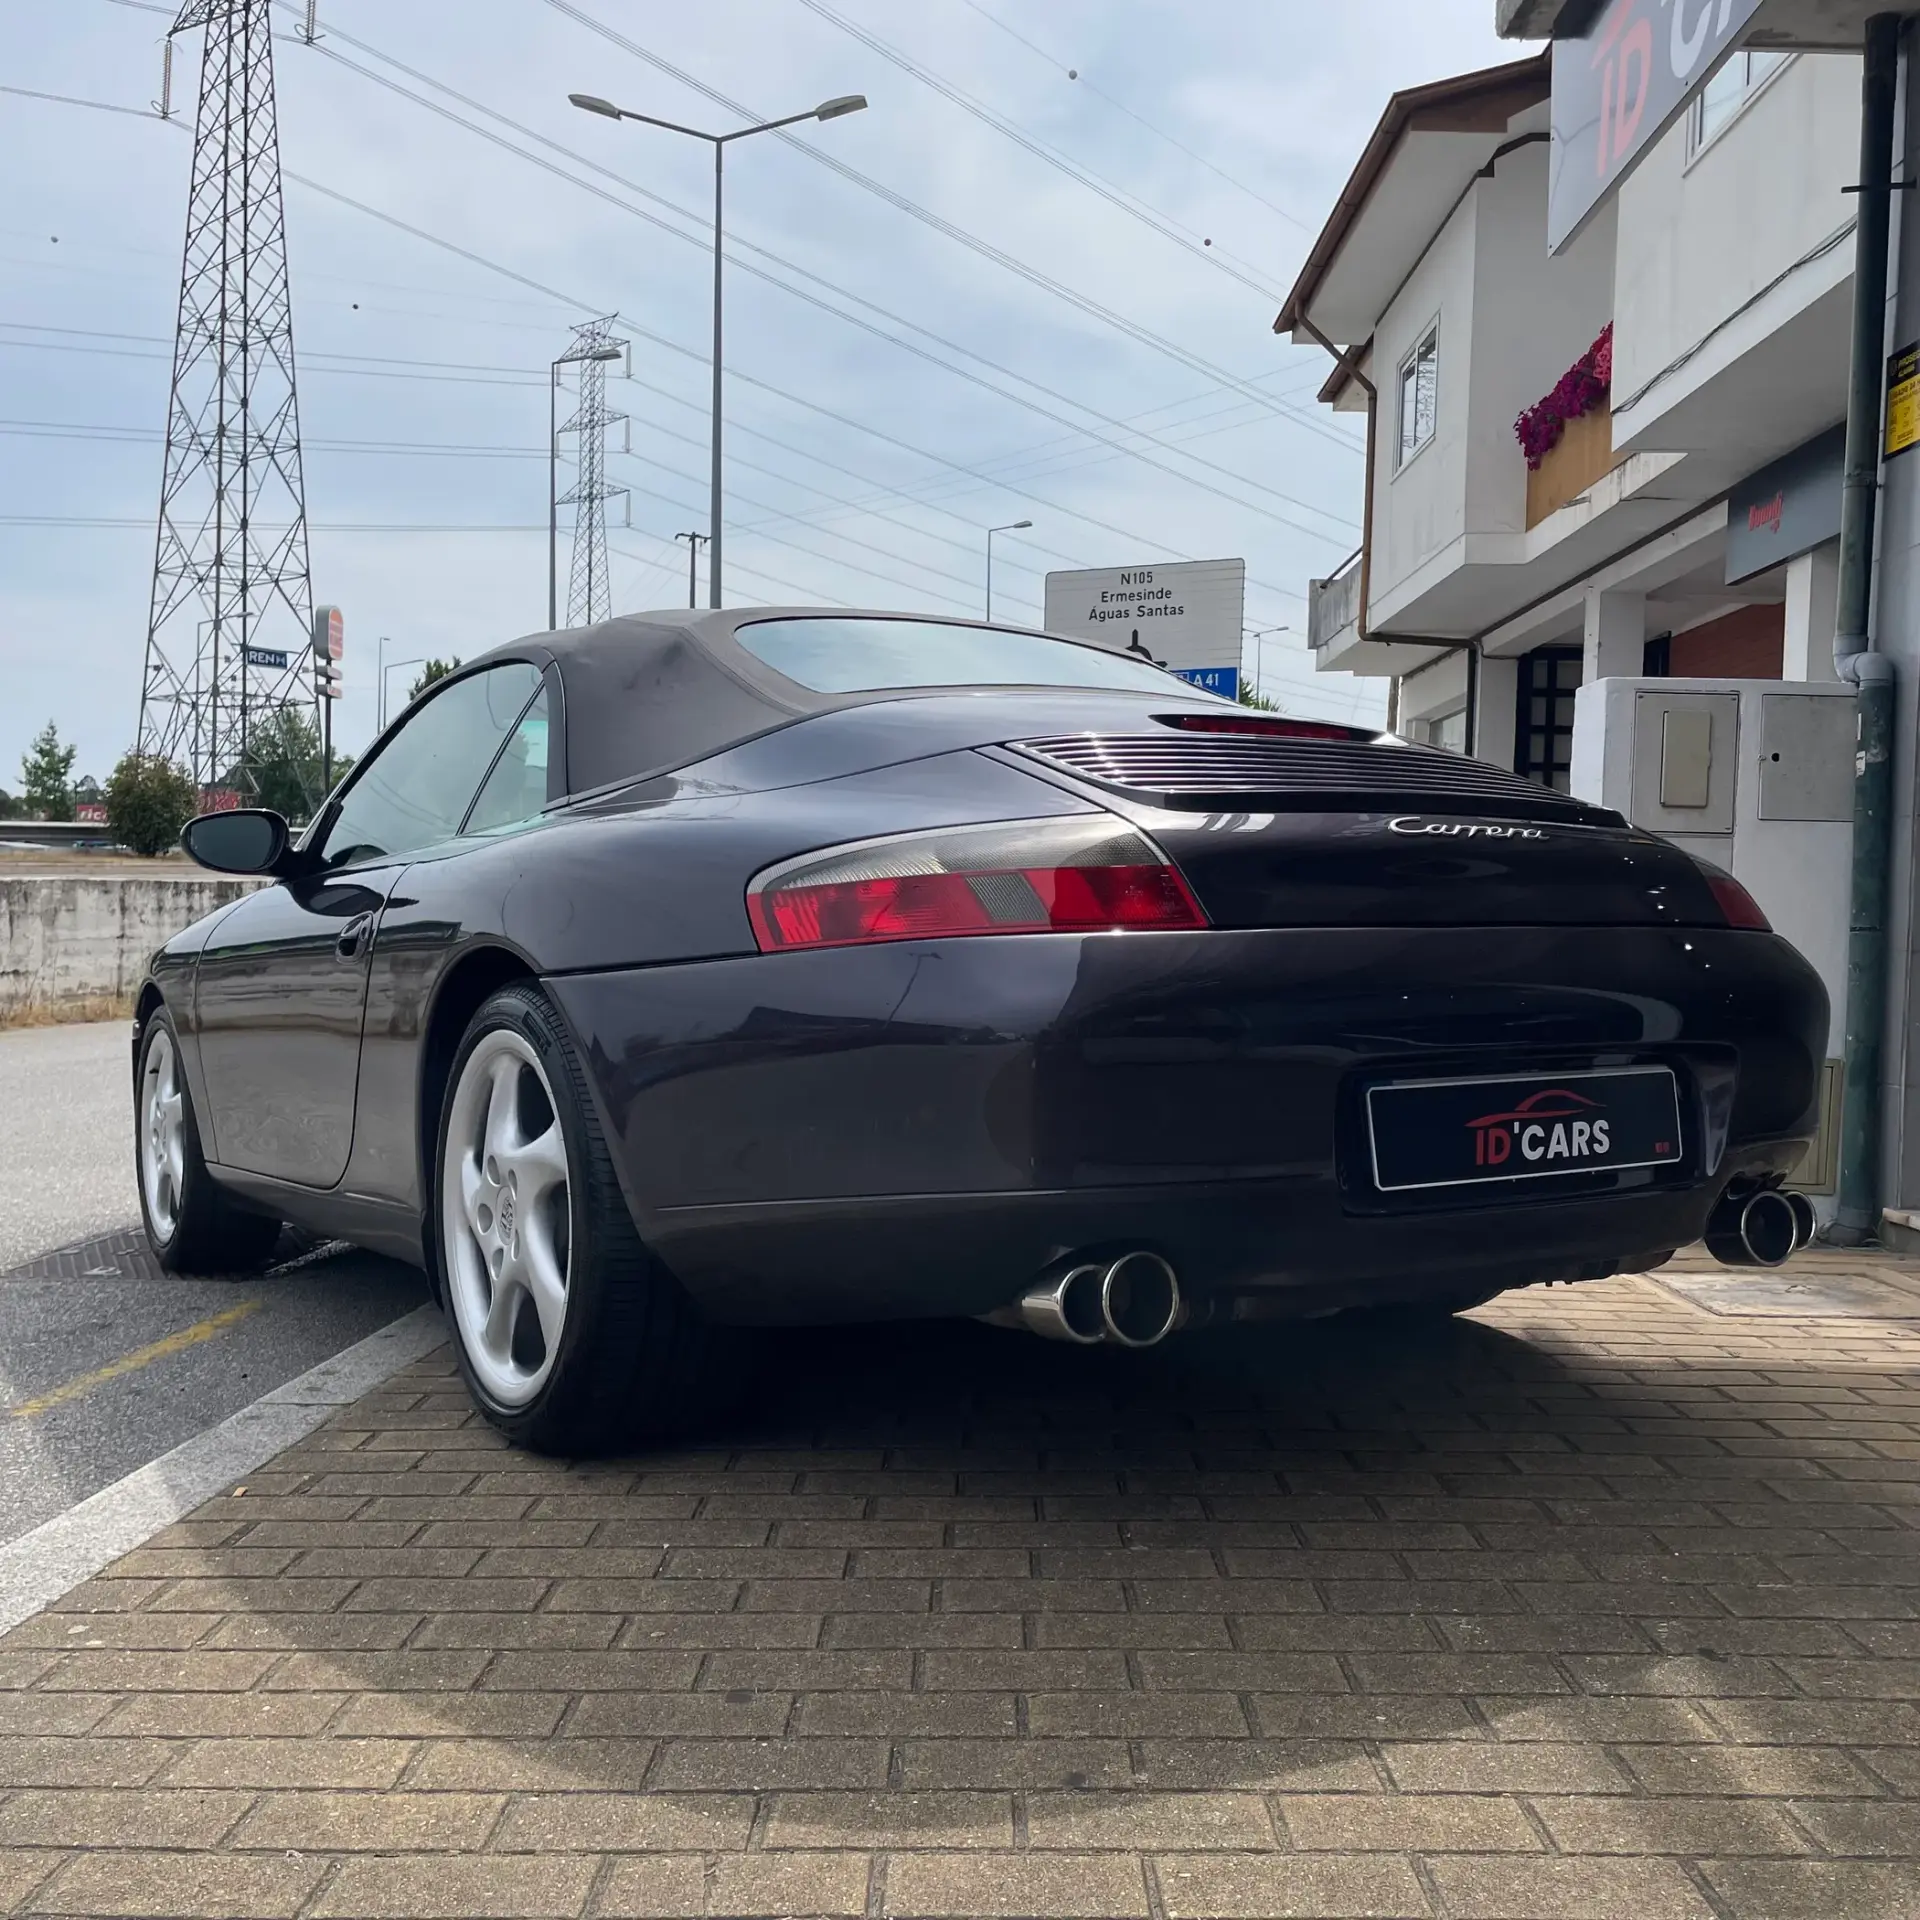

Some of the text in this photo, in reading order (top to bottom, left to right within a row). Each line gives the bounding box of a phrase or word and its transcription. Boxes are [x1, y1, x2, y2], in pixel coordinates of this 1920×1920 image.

[1120, 572, 1153, 585] N105
[1101, 587, 1173, 603] Ermesinde
[1088, 604, 1184, 622] Águas Santas
[249, 651, 275, 664] REN
[1193, 673, 1219, 688] A 41
[1388, 816, 1550, 840] Carrera
